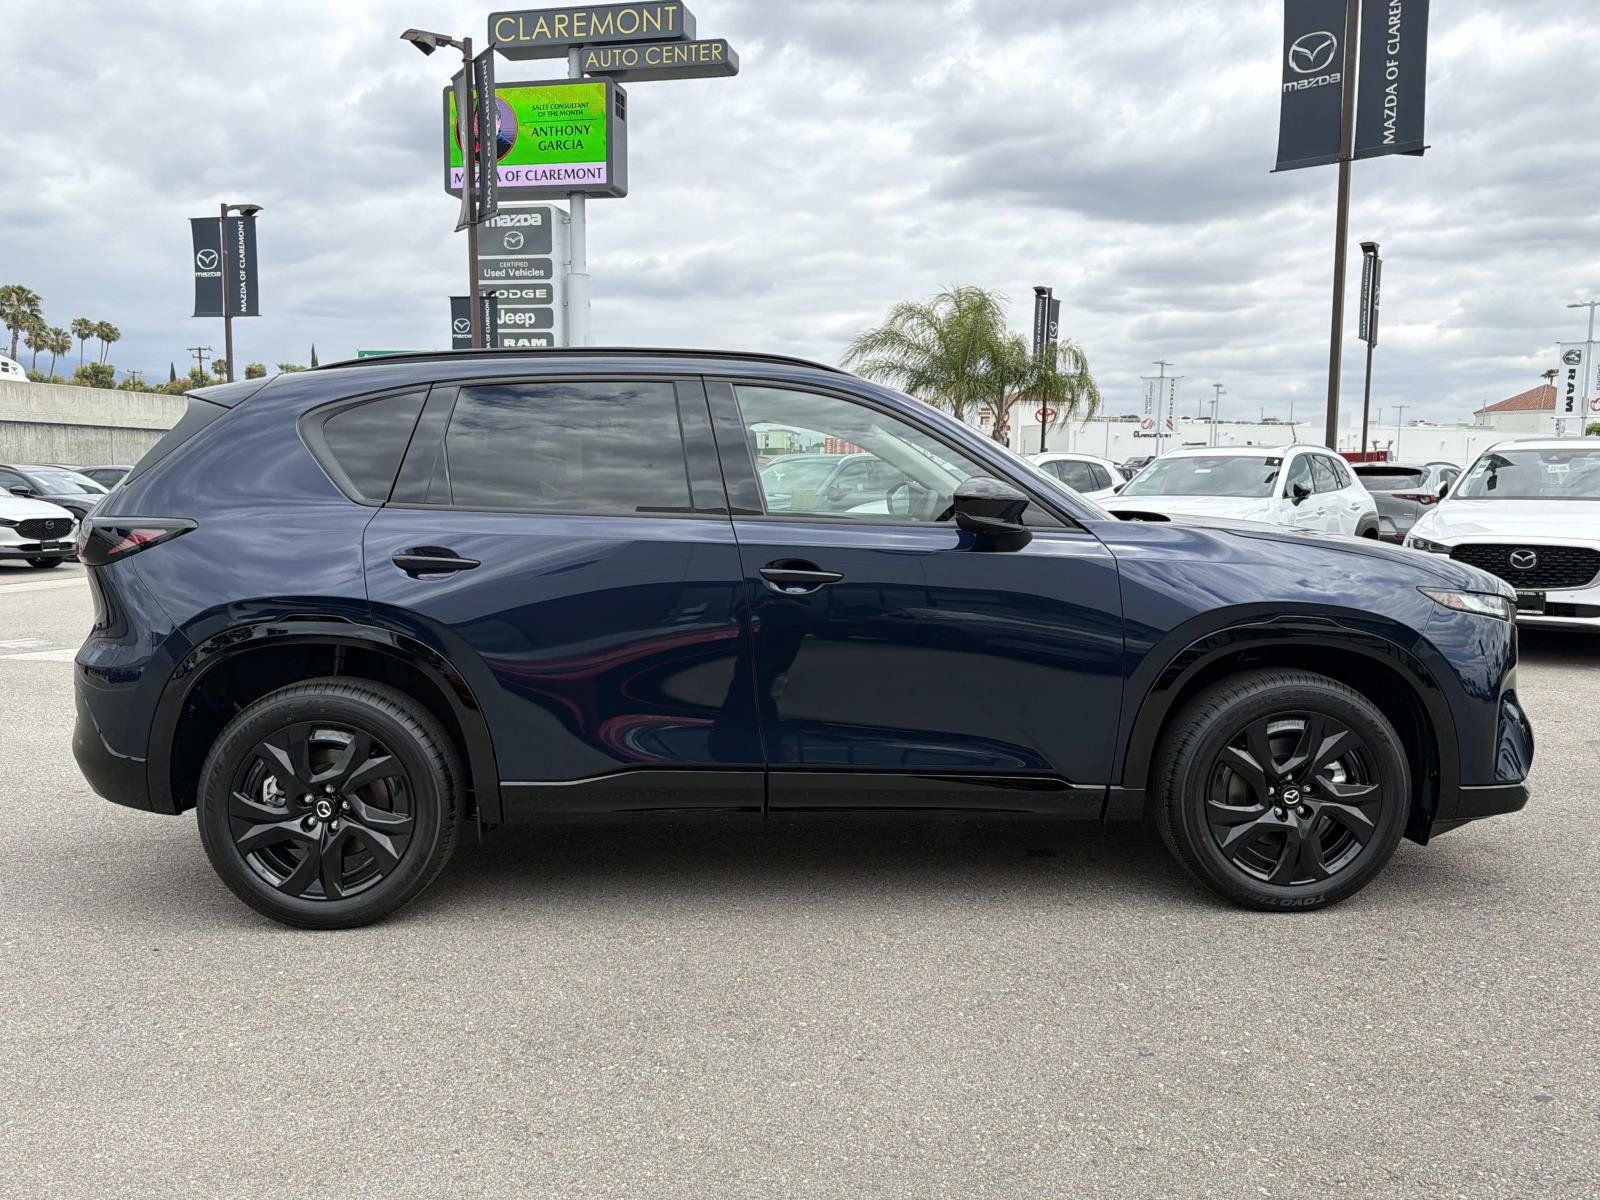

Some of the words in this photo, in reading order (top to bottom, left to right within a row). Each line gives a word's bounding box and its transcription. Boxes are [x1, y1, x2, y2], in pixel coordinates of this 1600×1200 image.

[495, 6, 677, 42] CLAREMONT
[586, 48, 638, 68] AUTO
[645, 43, 722, 64] CENTER
[1386, 60, 1399, 80] OF
[551, 102, 589, 110] CONSULTANT
[1383, 83, 1398, 144] MAZDA
[532, 125, 591, 137] ANTHONY
[538, 139, 584, 151] GARCIA
[505, 170, 522, 182] OF
[525, 167, 603, 182] CLAREMONT
[238, 220, 246, 268] CLAREMONT
[240, 269, 246, 281] OF
[484, 269, 506, 277] Used
[508, 267, 545, 277] Vehicles
[497, 309, 536, 328] Jeep
[503, 338, 547, 348] RAM
[1565, 368, 1576, 412] RAM
